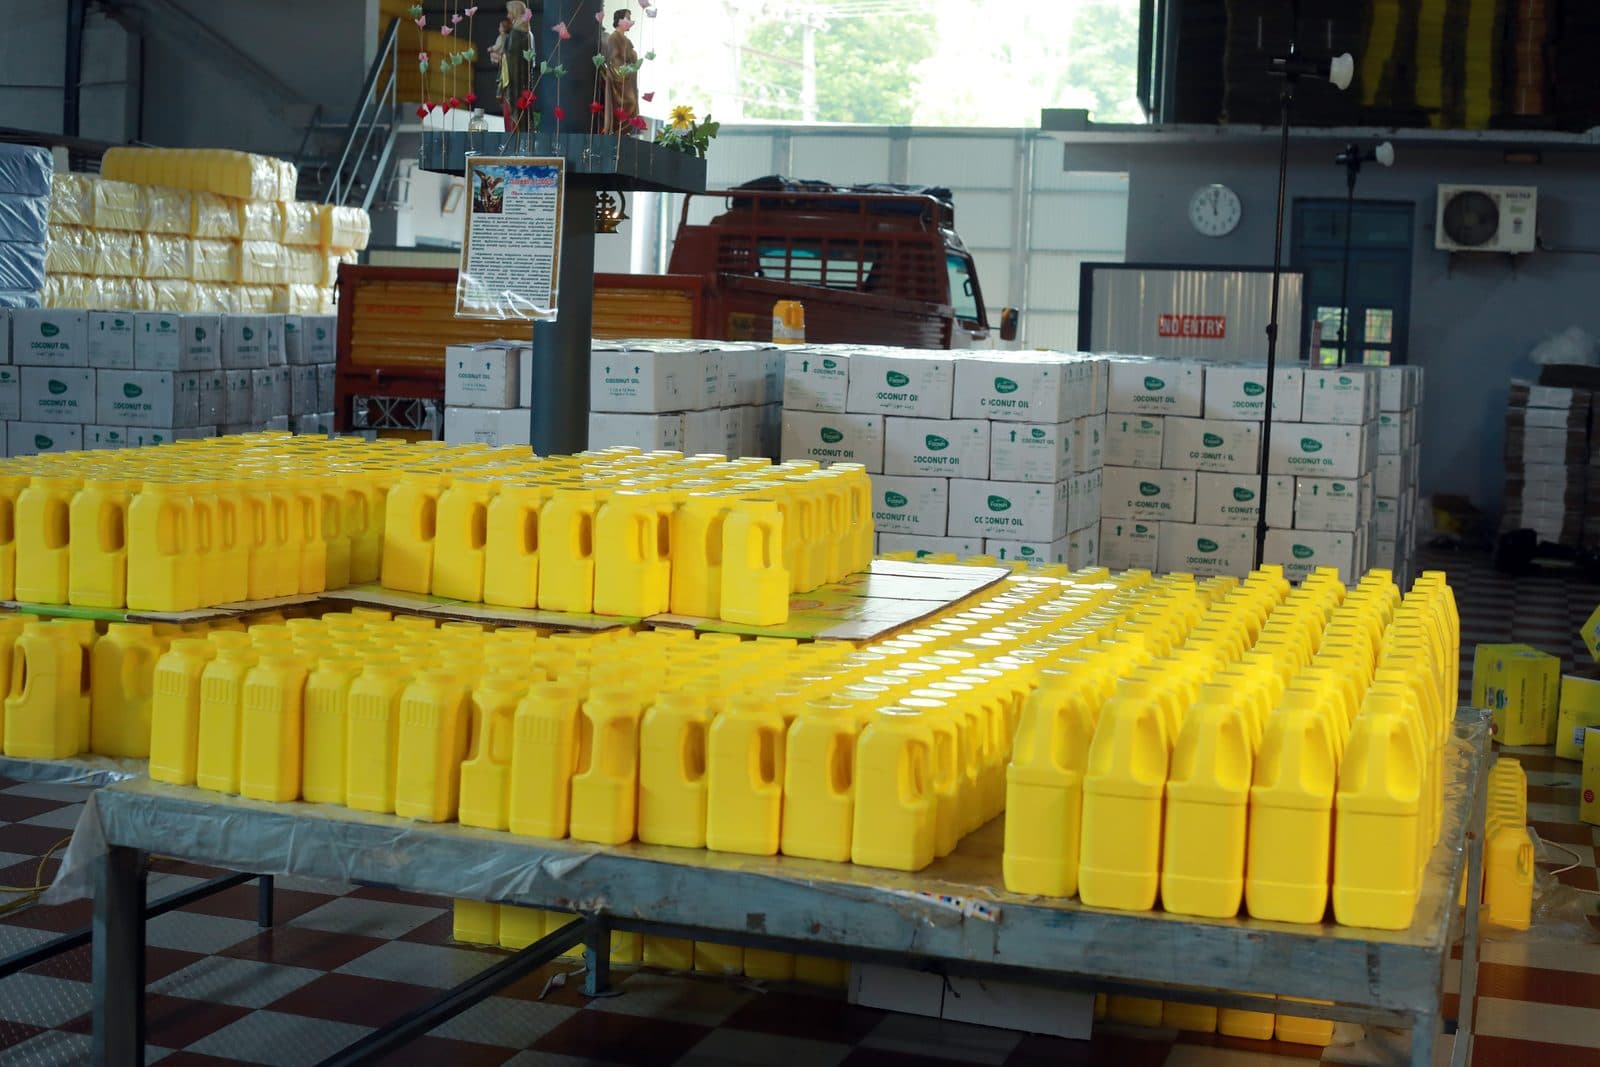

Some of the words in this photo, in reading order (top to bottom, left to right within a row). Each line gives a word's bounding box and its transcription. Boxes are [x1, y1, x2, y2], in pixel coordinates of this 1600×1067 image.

[1161, 318, 1179, 334] NO
[1183, 318, 1225, 336] ENTRY
[31, 342, 58, 350] COCONUT
[39, 399, 66, 407] COCONUT
[980, 398, 1016, 408] CCONUT
[1018, 400, 1029, 408] OIL
[1287, 457, 1321, 465] COCONUT
[1127, 500, 1159, 508] CCONUT
[1011, 518, 1024, 526] OIL
